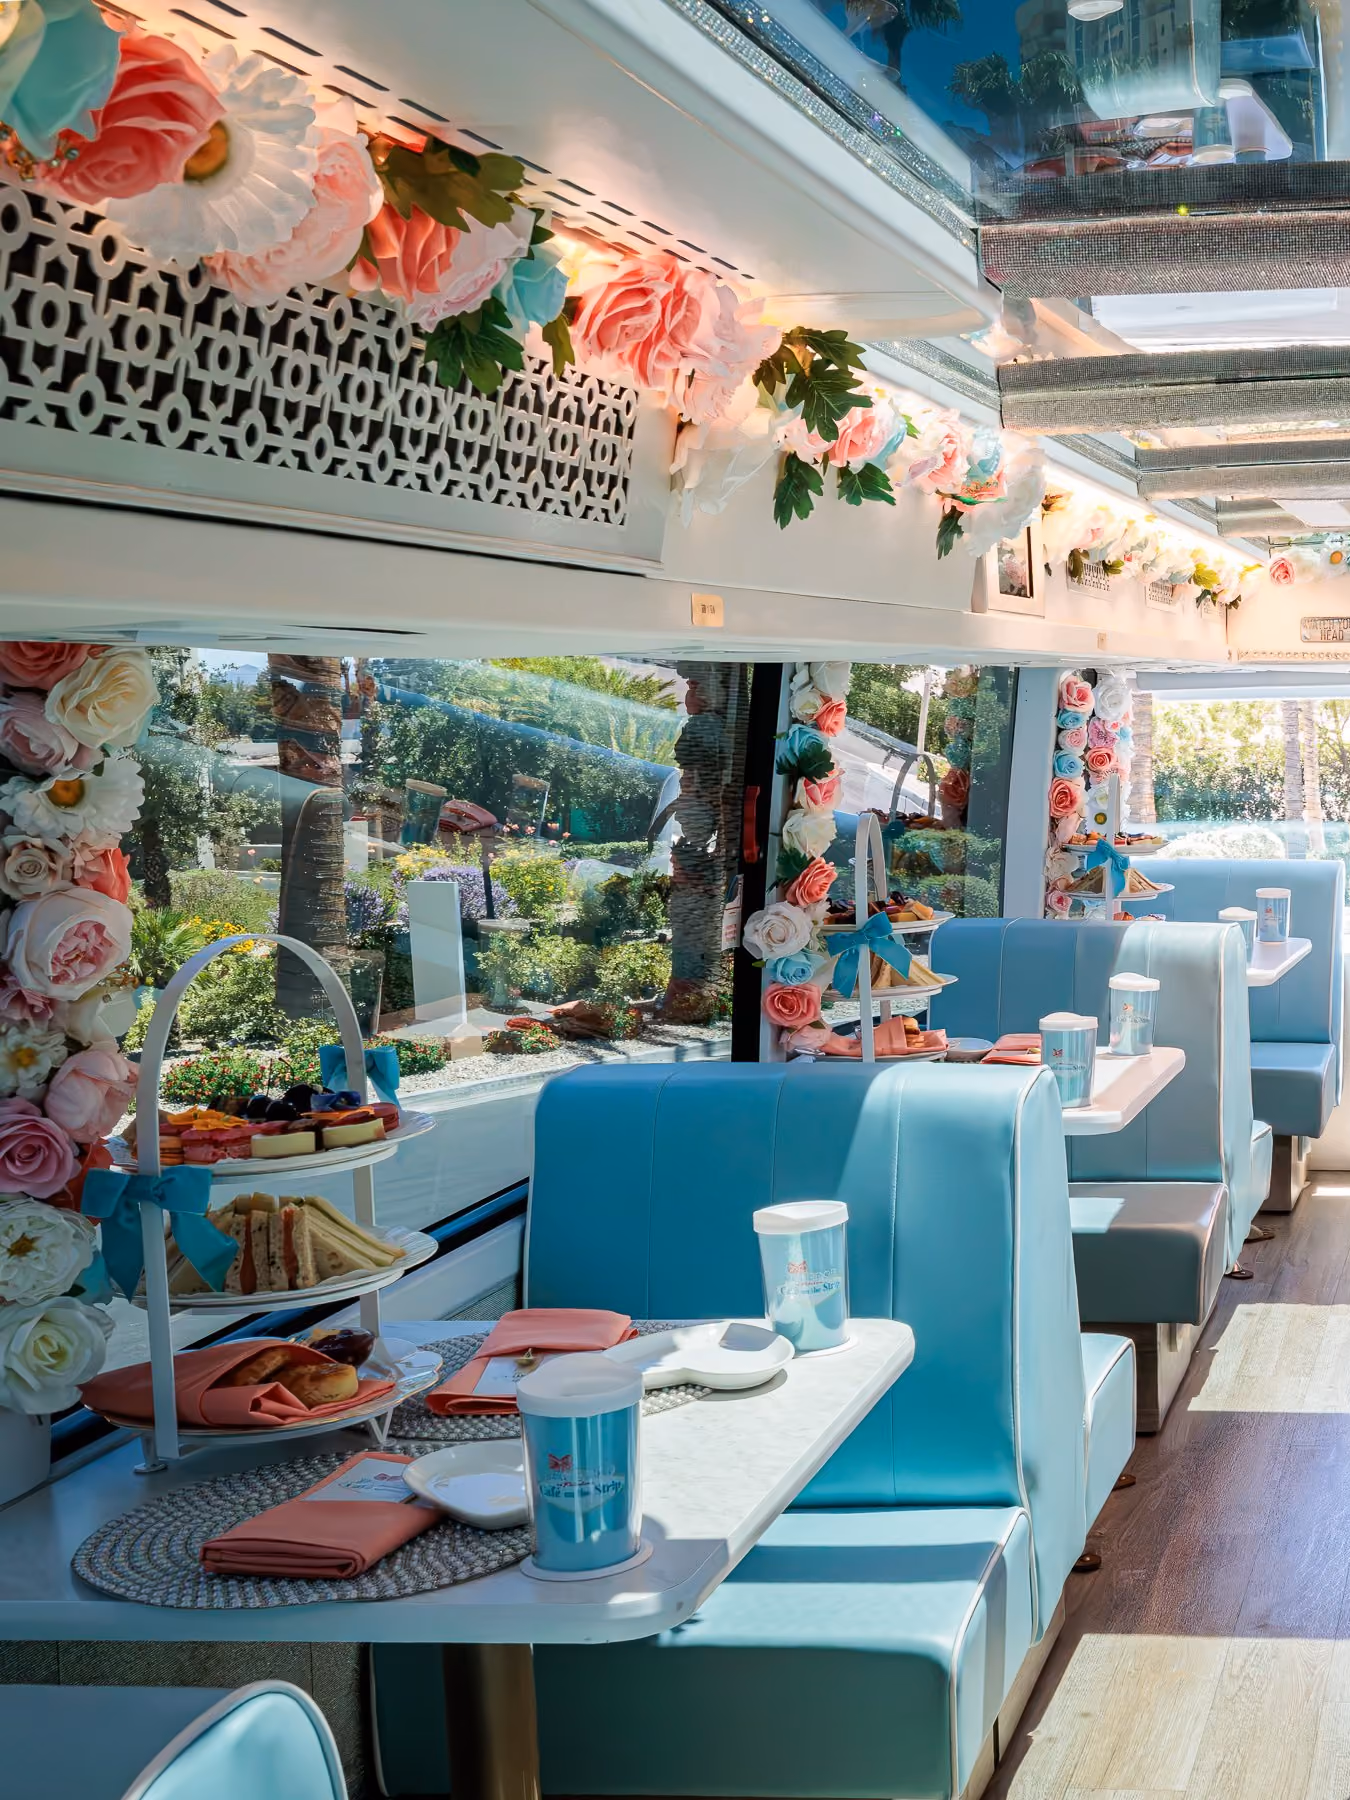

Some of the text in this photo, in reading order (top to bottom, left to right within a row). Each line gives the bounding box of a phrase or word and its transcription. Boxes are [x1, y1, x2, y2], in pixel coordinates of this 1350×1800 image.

[1303, 619, 1335, 630] WATCH
[1320, 629, 1344, 641] HEAD
[594, 1480, 622, 1496] Strip
